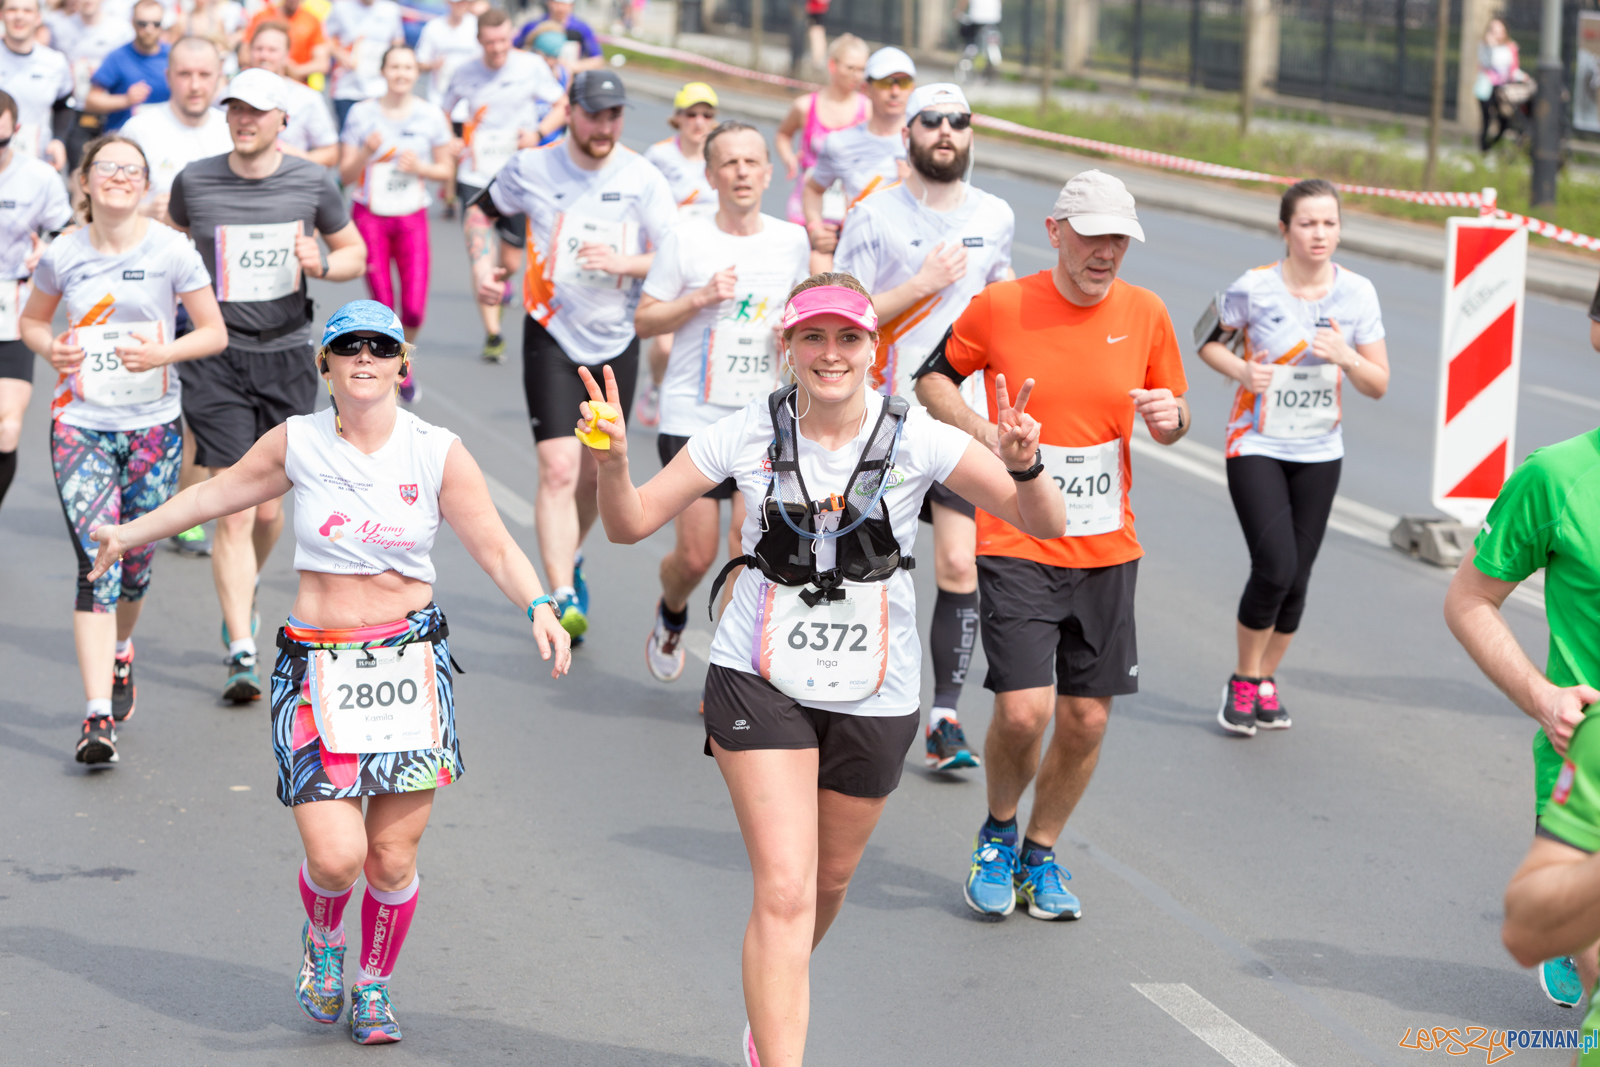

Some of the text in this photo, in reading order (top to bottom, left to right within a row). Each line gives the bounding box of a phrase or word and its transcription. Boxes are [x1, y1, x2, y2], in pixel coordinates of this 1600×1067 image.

[239, 248, 289, 269] 6527
[90, 352, 124, 372] 35
[727, 354, 770, 373] 7315
[1275, 389, 1333, 408] 10275
[1068, 502, 1094, 511] Maciej
[354, 520, 405, 537] Mamy
[361, 532, 417, 551] Biegamy
[787, 621, 868, 652] 6372
[952, 608, 979, 684] Kalenji
[816, 658, 838, 669] Inga
[336, 678, 418, 710] 2800
[364, 713, 394, 722] Kamila
